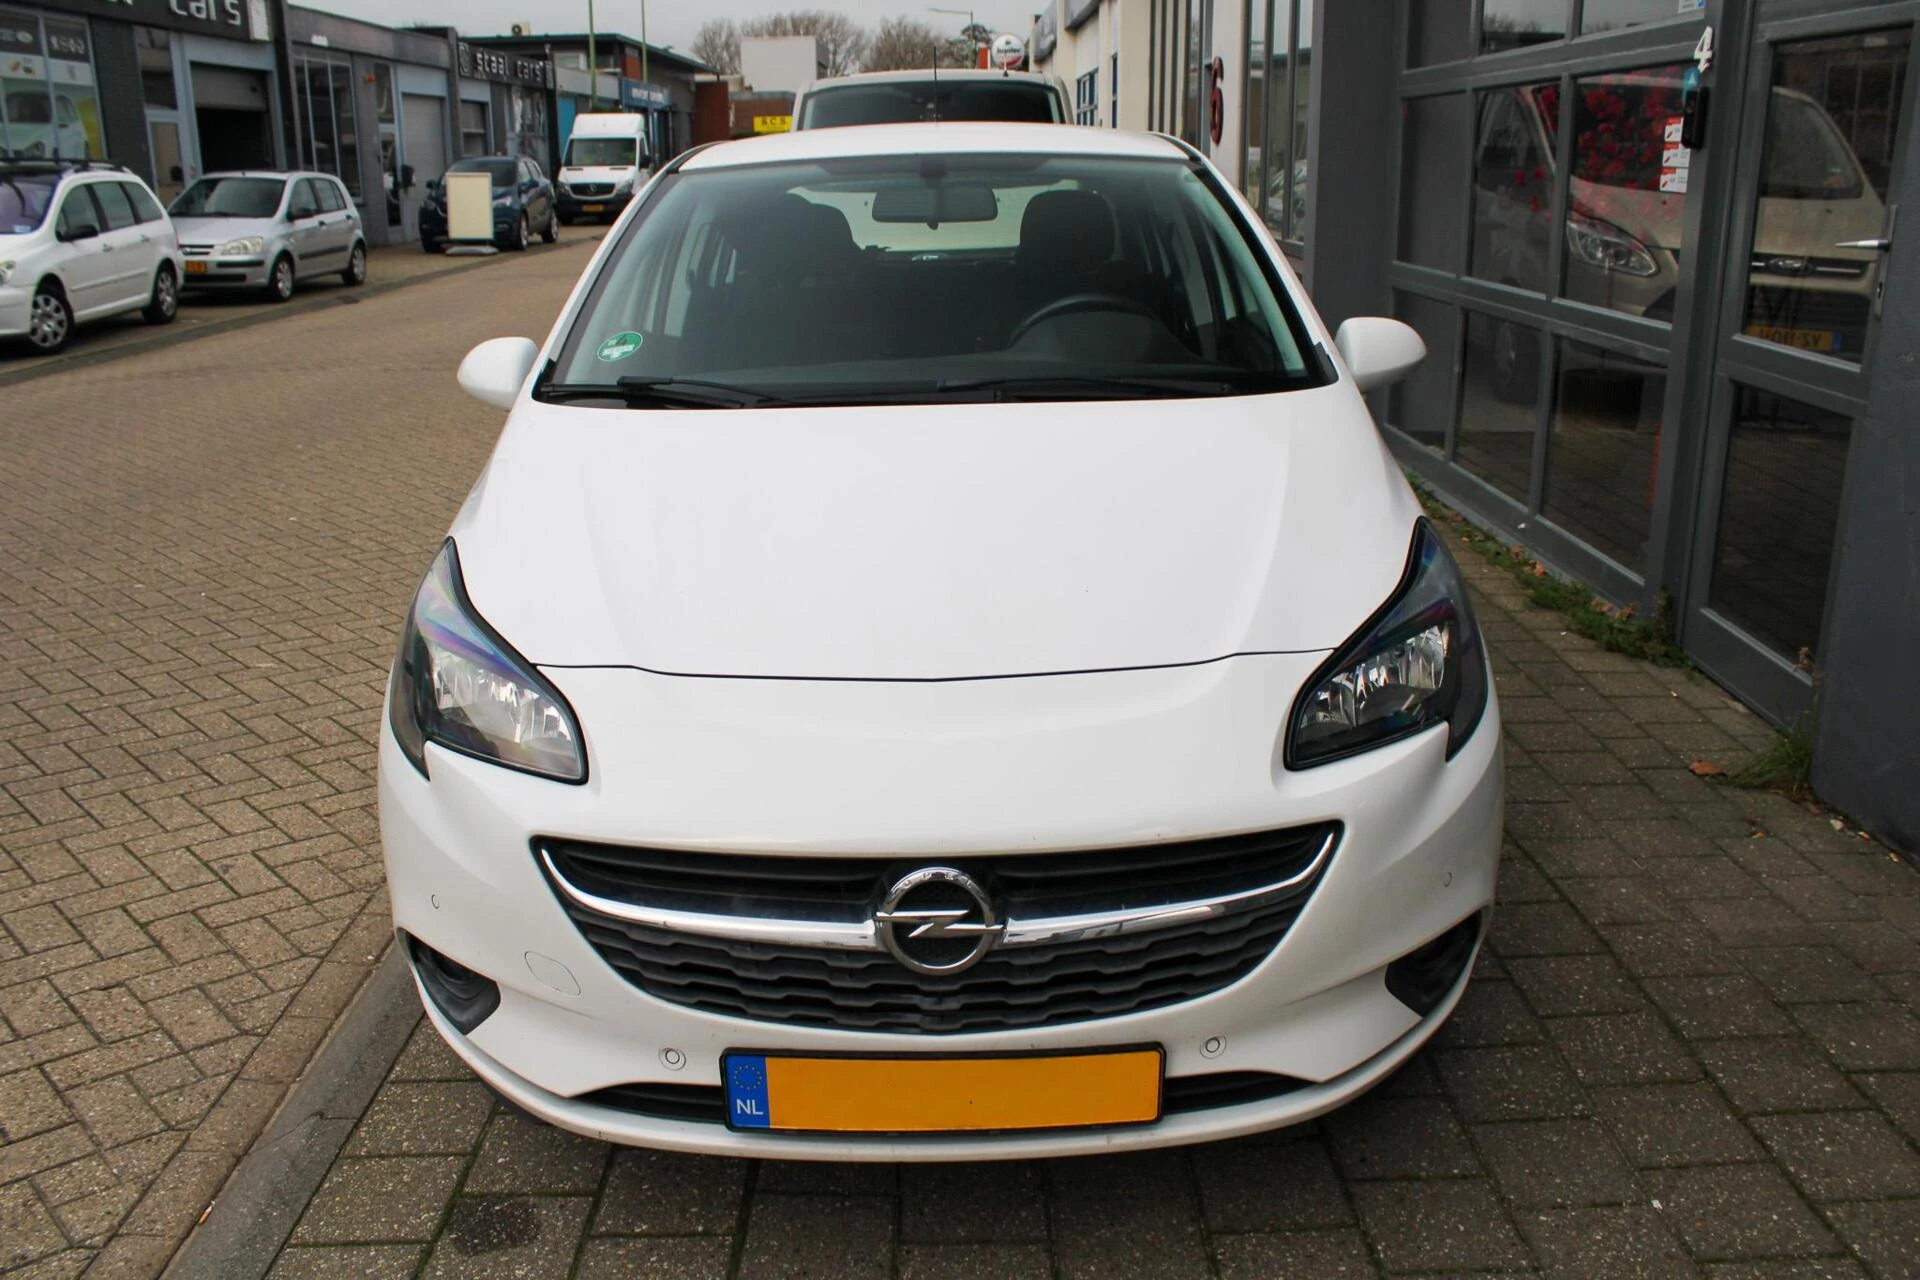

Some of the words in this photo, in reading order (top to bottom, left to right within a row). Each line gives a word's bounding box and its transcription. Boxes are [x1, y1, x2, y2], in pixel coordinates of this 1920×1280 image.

[476, 51, 508, 76] staal
[516, 60, 542, 82] cars
[1693, 25, 1713, 74] 4
[1210, 56, 1224, 146] 6
[736, 1098, 764, 1116] NL
